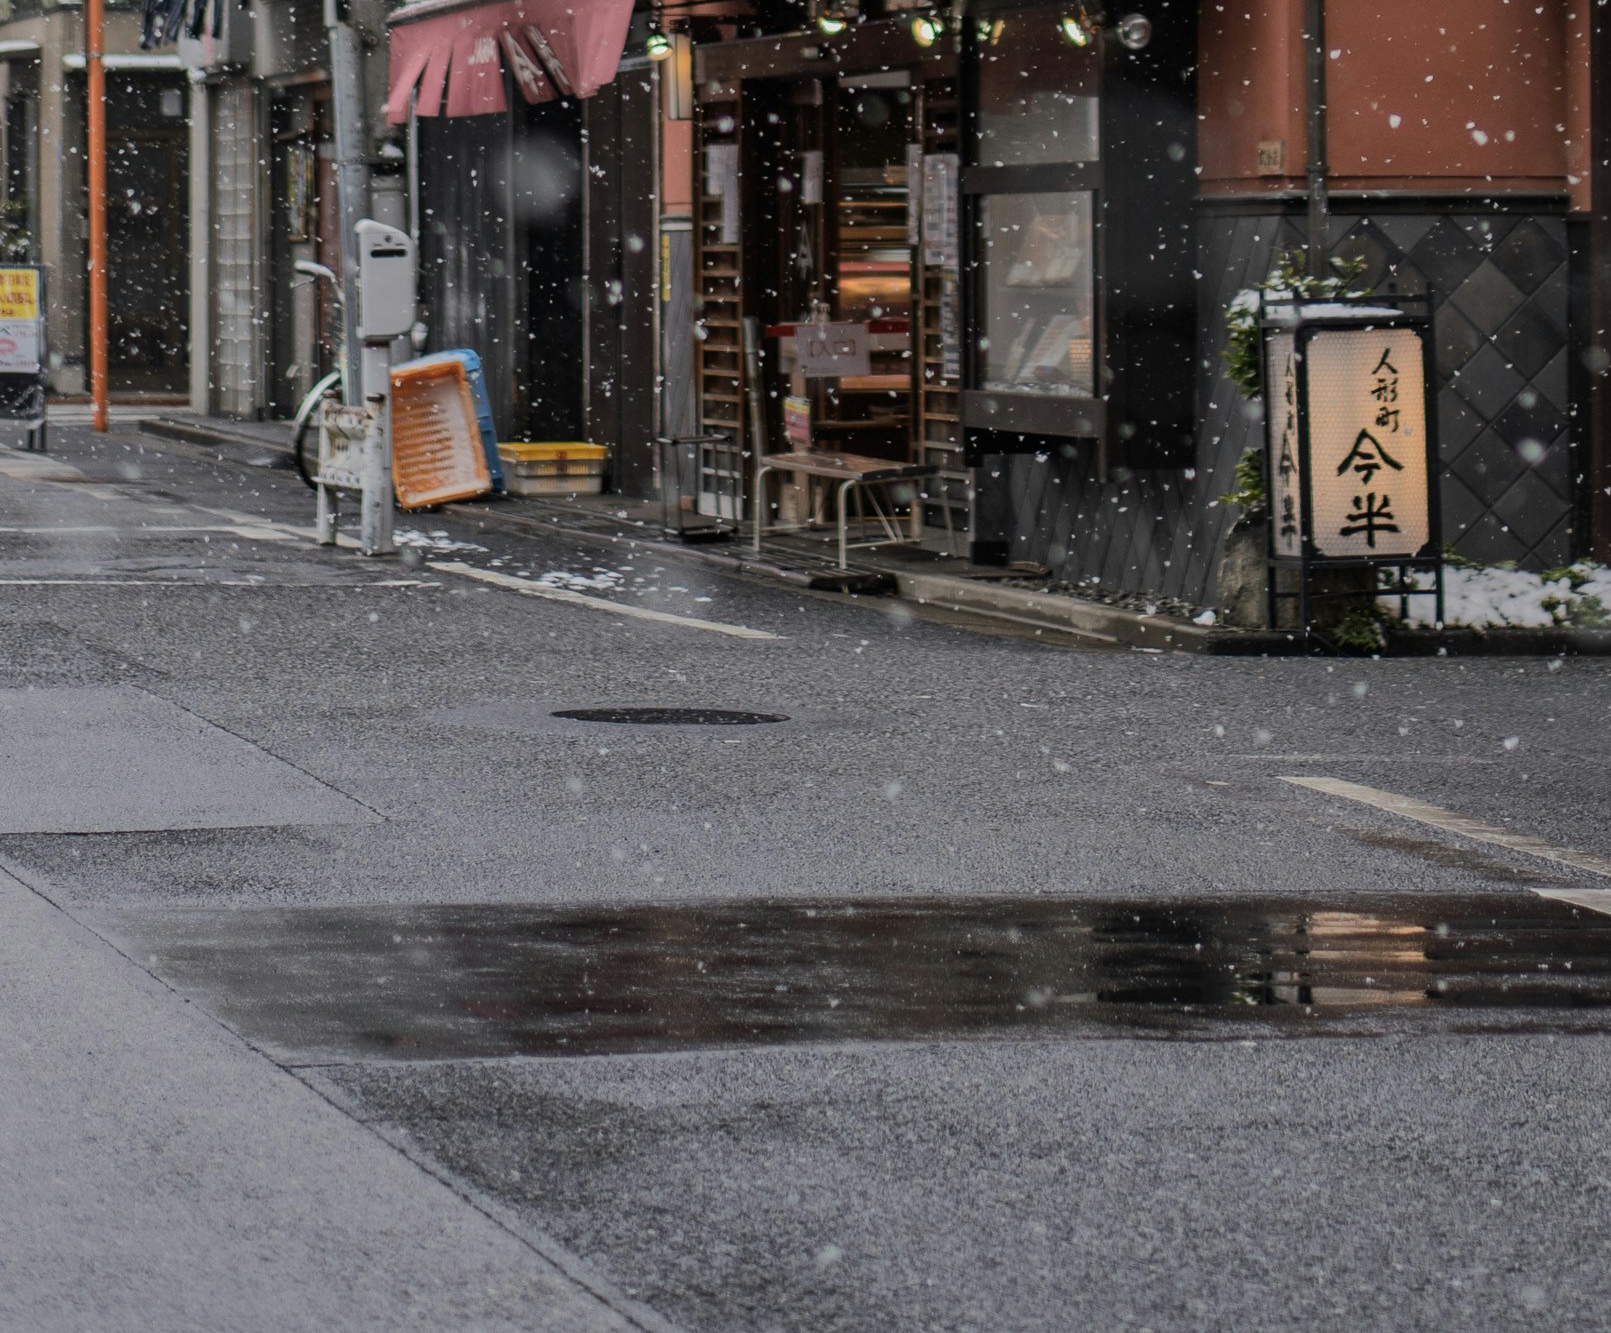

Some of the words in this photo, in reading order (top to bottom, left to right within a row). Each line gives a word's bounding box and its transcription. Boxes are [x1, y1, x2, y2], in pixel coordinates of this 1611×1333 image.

[1370, 347, 1401, 433] 人形町
[1337, 428, 1405, 549] 今半
